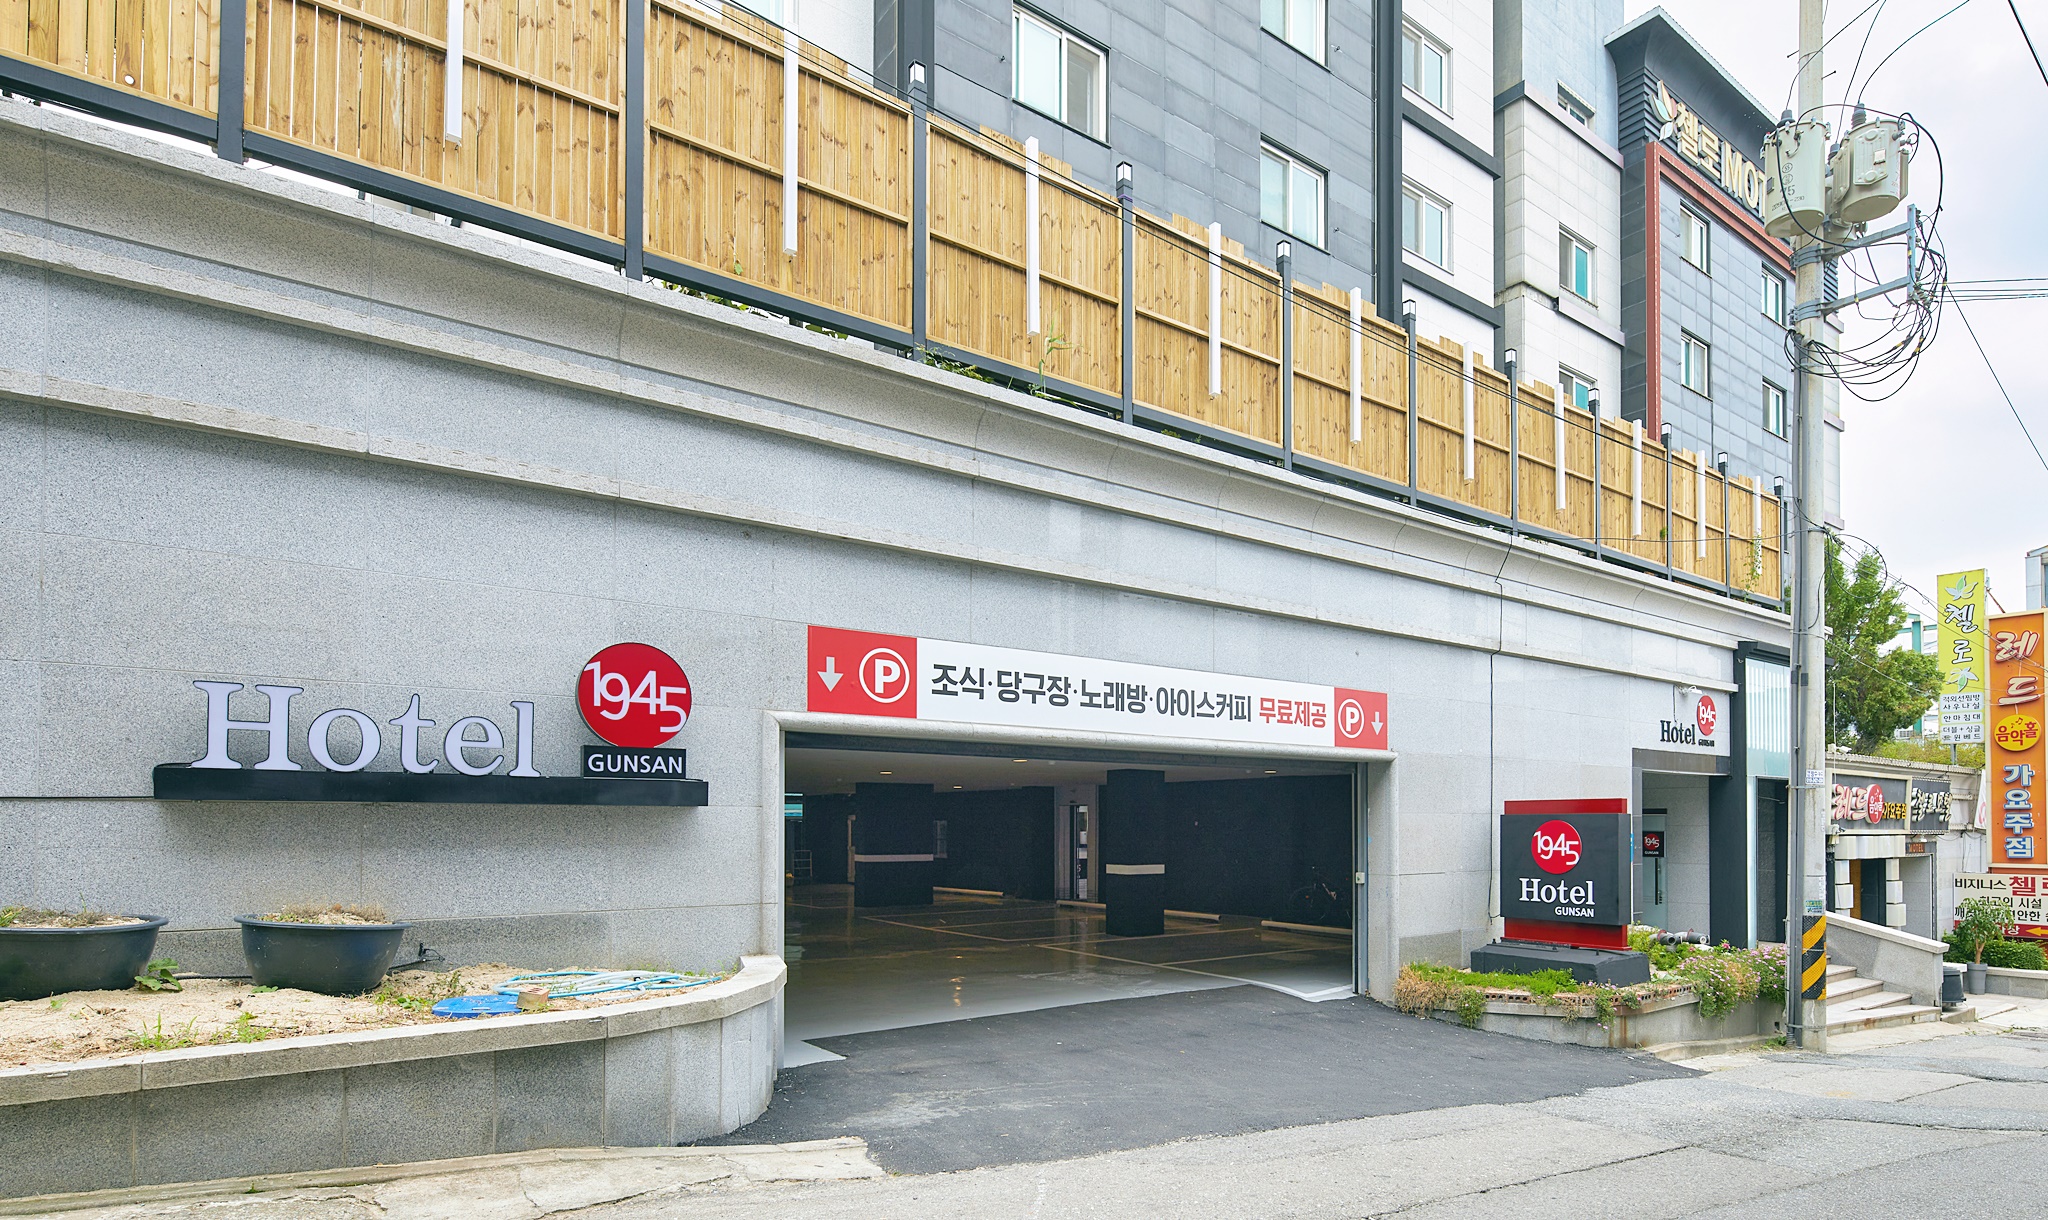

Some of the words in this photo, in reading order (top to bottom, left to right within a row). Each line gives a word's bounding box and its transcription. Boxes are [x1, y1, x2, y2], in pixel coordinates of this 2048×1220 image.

[1675, 102, 1721, 179] 첼로
[1944, 603, 1979, 665] 첼로
[1994, 630, 2040, 706] 레드
[583, 661, 688, 734] 1945
[1259, 697, 1327, 729] 무료제공
[1698, 702, 1716, 730] 1945
[192, 680, 541, 777] Hotel
[1660, 719, 1696, 745] Hotel
[1996, 721, 2039, 746] 음악홀
[587, 753, 683, 775] GUNSAN
[1832, 784, 1867, 821] 레드
[2003, 764, 2035, 859] 가요주점
[1532, 830, 1580, 866] 1945
[1644, 836, 1660, 848] 1945
[1519, 877, 1596, 905] Hotel
[1954, 878, 2007, 890] 비지니스
[2009, 875, 2048, 897] 첼
[1555, 906, 1595, 918] GUNSAN
[2018, 898, 2042, 910] 시설
